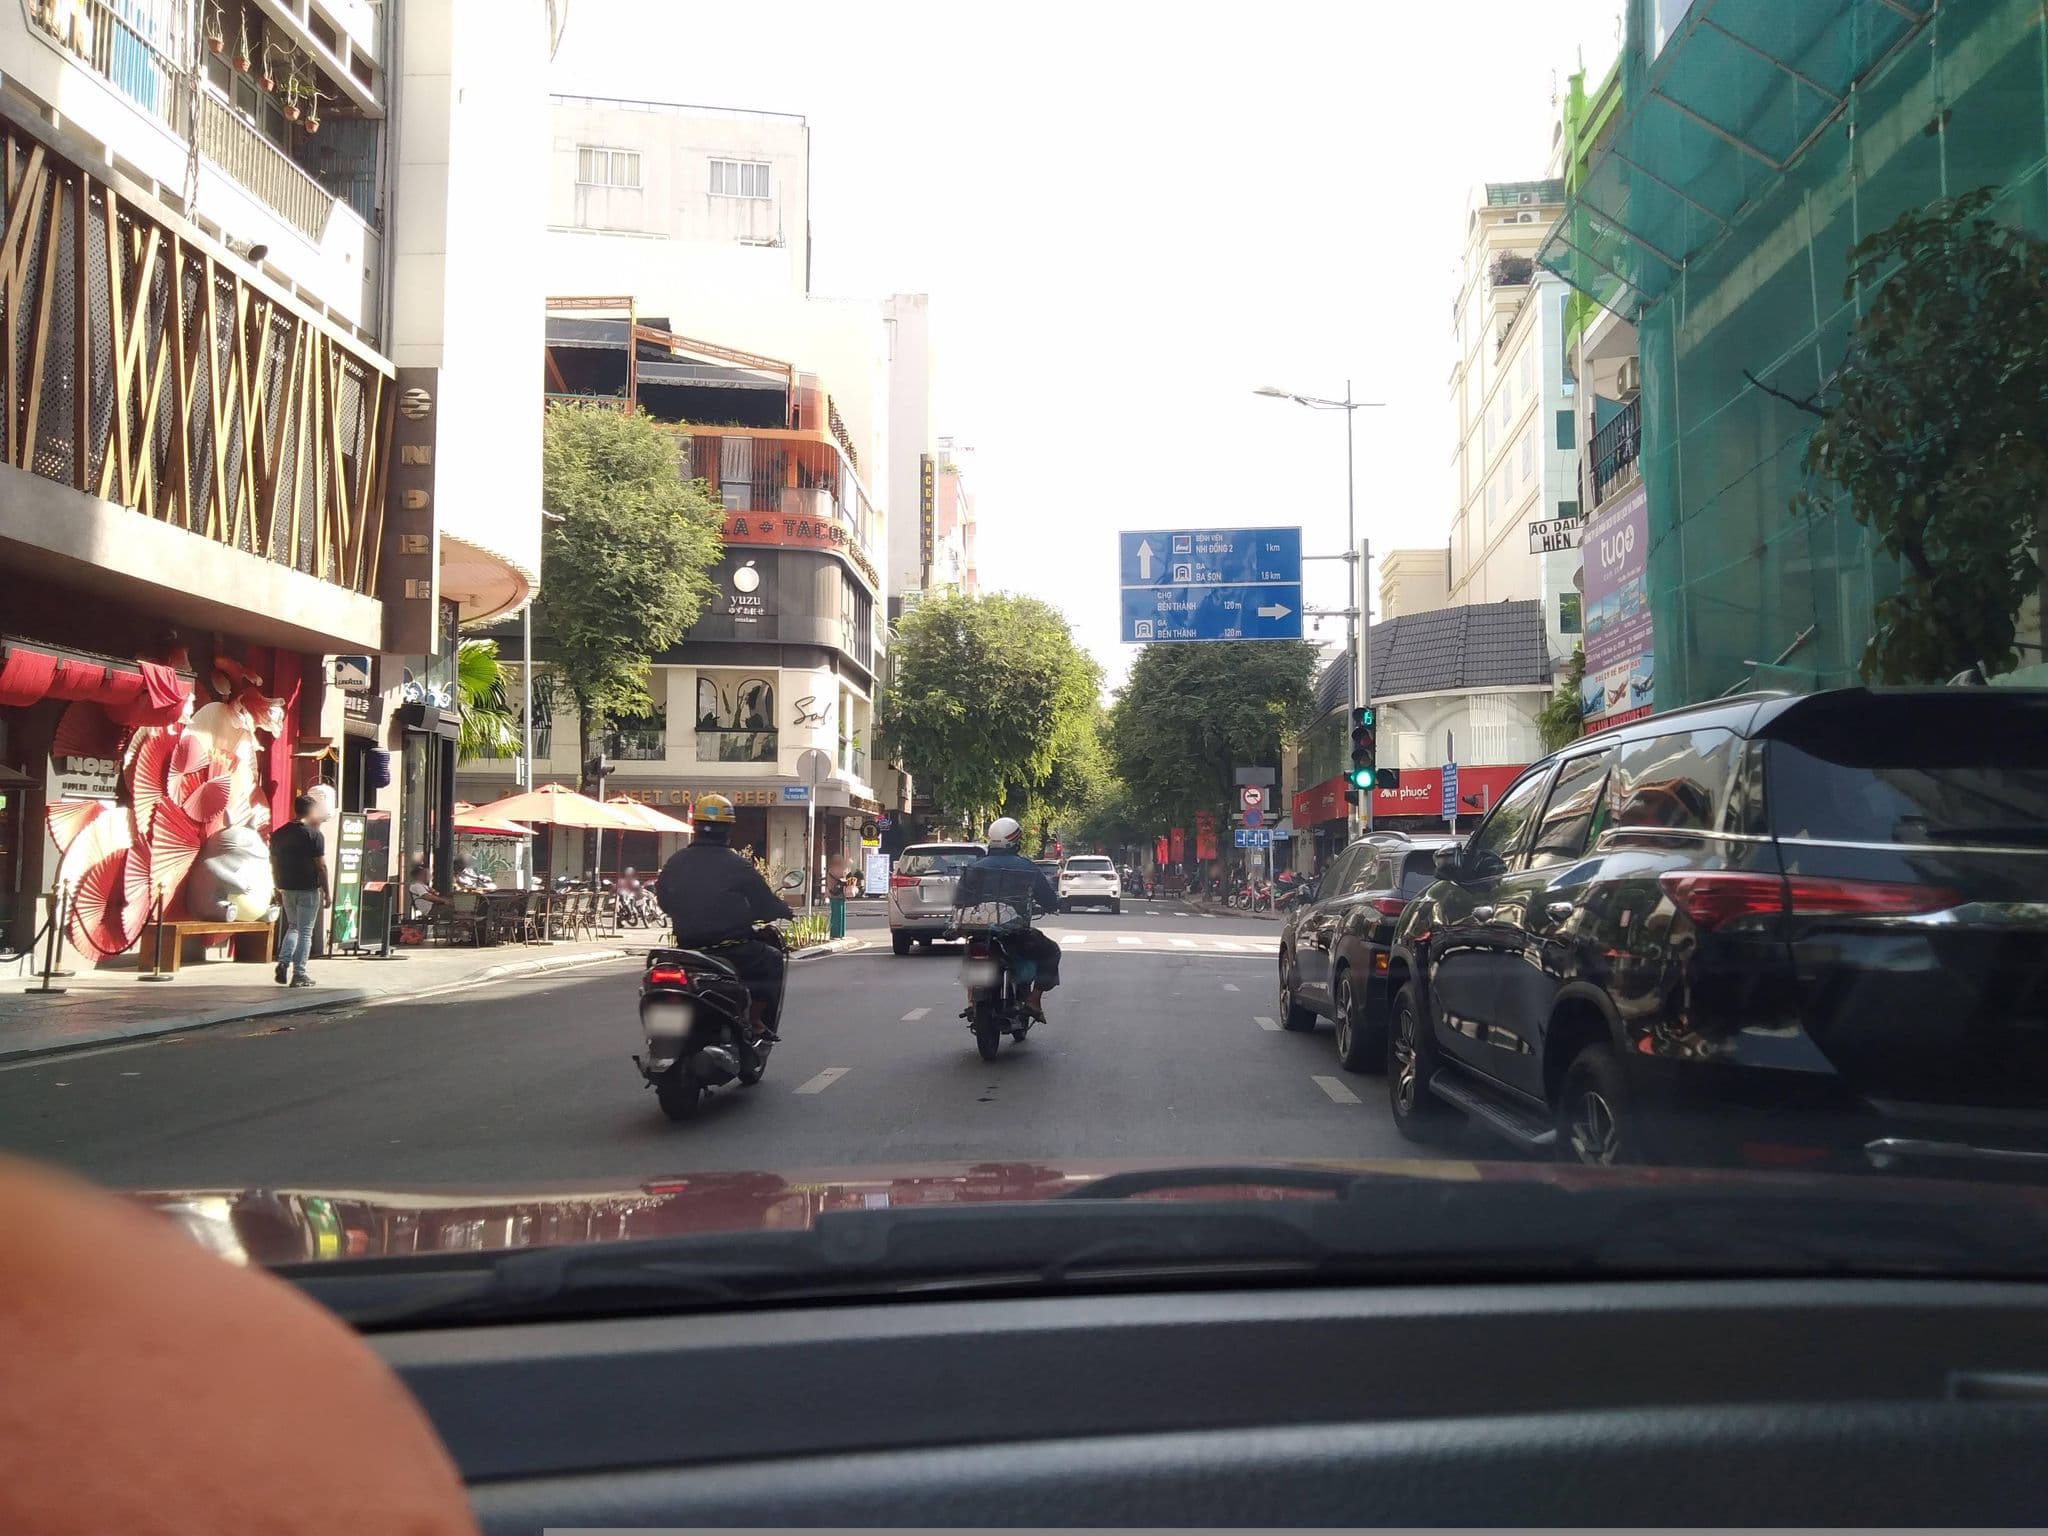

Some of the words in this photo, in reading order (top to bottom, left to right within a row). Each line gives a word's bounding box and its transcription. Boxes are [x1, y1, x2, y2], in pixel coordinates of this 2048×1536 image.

[1228, 544, 1233, 553] 2
[1269, 543, 1280, 552] km
[1270, 571, 1280, 580] km
[730, 595, 761, 607] yuzu
[1234, 602, 1241, 610] m
[734, 790, 778, 805] BEER
